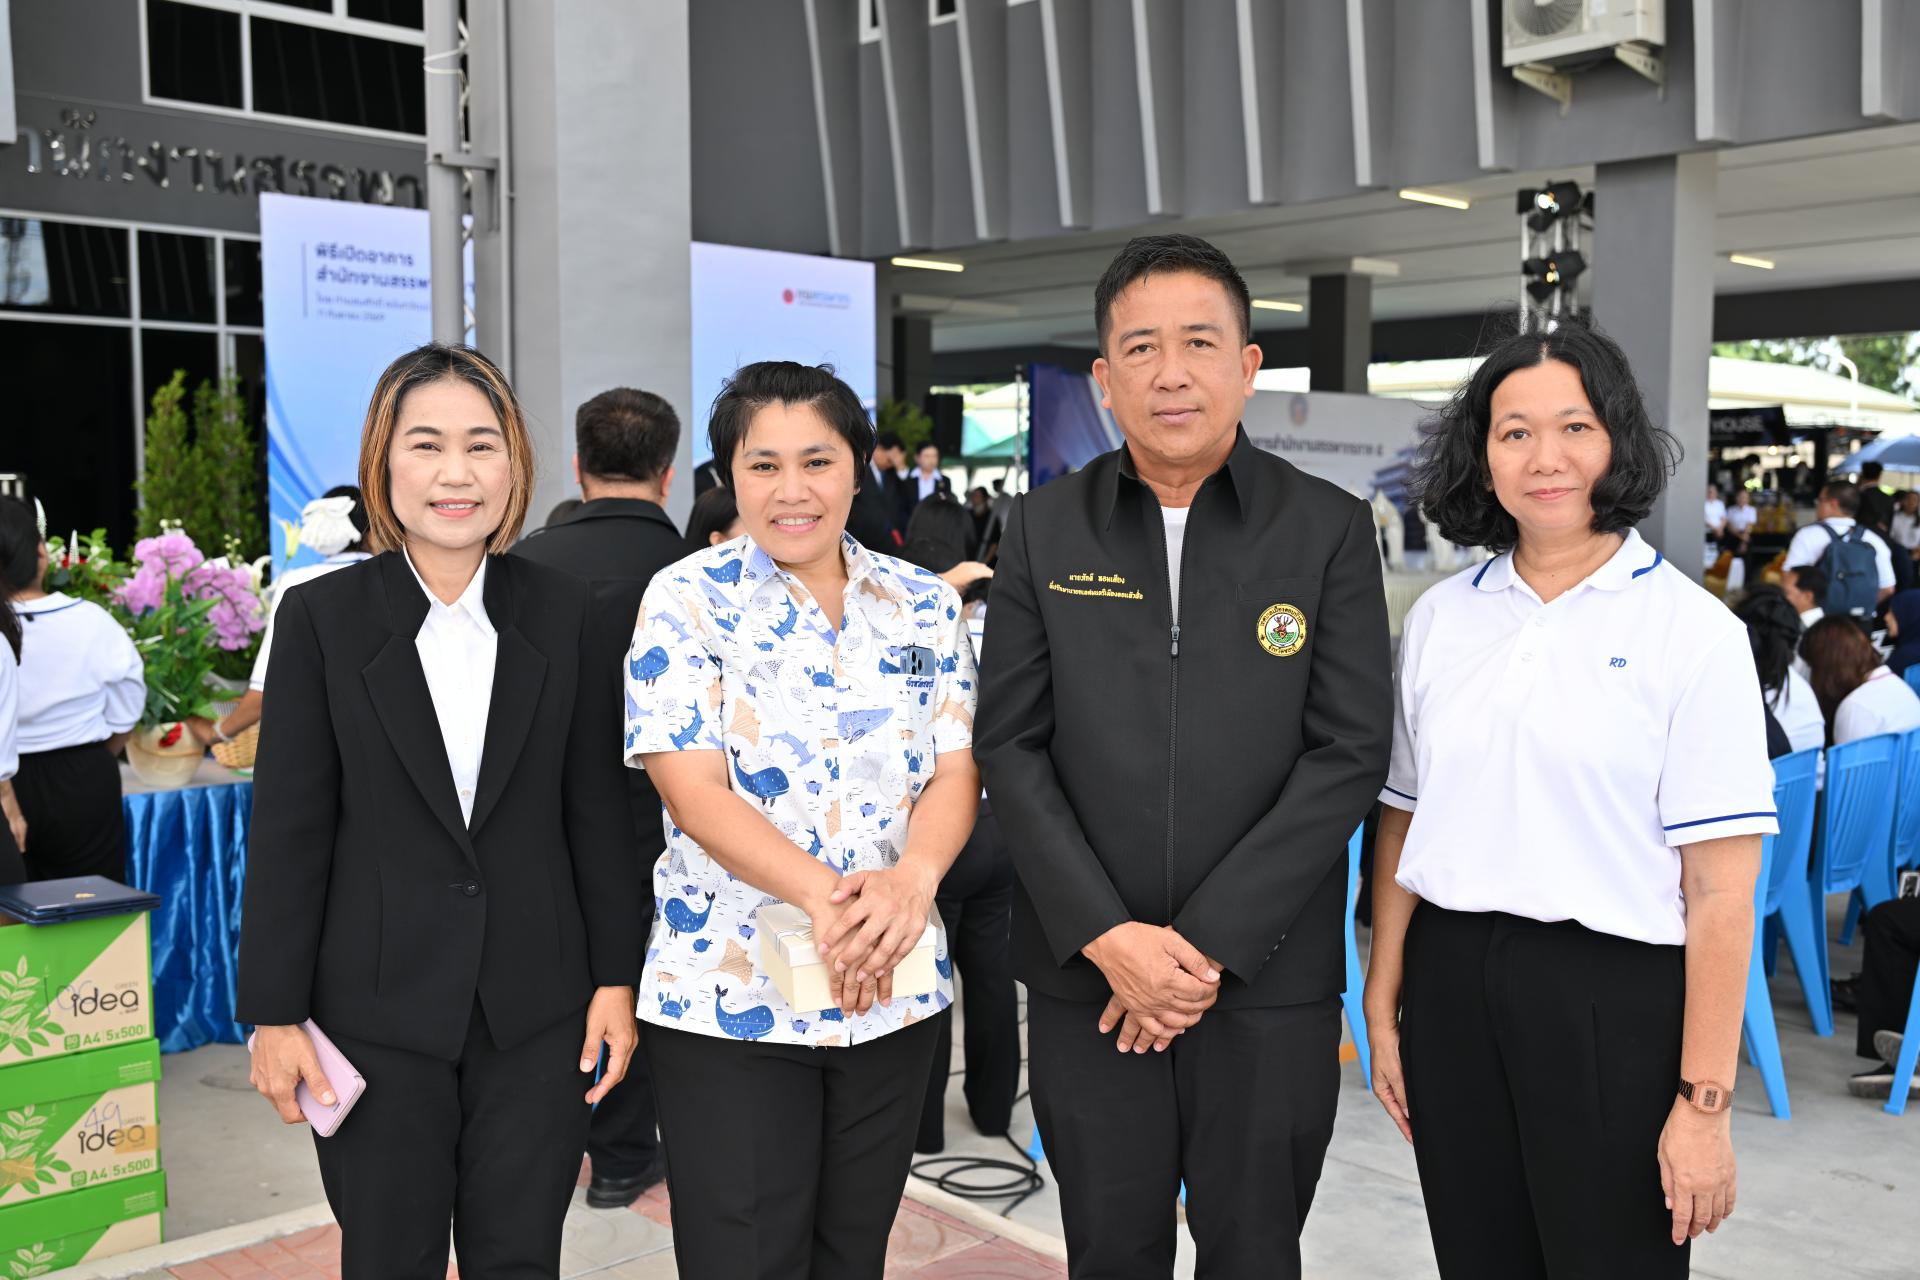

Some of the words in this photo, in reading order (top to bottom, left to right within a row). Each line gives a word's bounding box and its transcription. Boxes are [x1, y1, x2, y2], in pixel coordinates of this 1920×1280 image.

[315, 242, 415, 266] พิธีเปิดอาคาร
[316, 264, 432, 289] สำนักงานสรรพ
[1608, 656, 1627, 668] RD
[71, 987, 139, 1018] idea
[83, 1032, 101, 1046] A4
[106, 1024, 144, 1041] 5x500
[78, 1123, 146, 1155] idea
[89, 1168, 108, 1182] A4
[112, 1158, 151, 1177] 5x500
